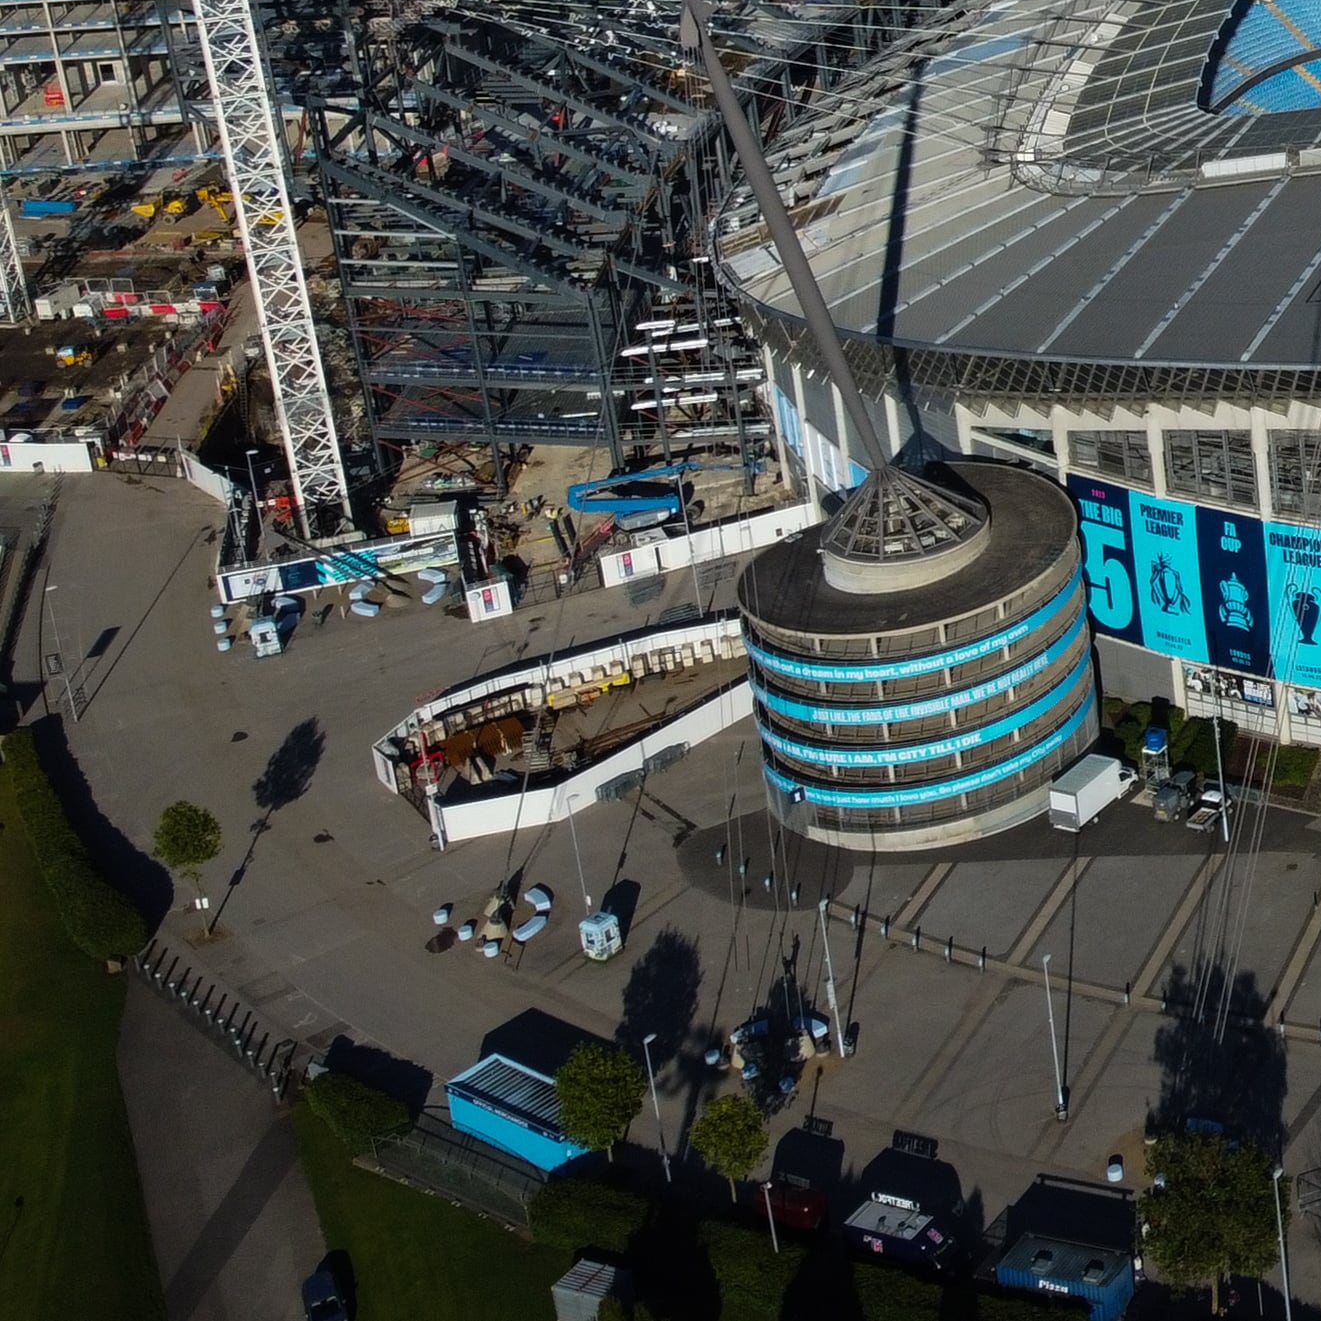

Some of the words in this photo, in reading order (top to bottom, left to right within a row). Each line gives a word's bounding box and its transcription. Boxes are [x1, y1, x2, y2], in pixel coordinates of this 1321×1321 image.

[1078, 498, 1100, 520] THE
[1101, 505, 1123, 528] BIG
[1140, 503, 1184, 526] PREMIER
[1145, 521, 1181, 541] LEAGUE
[1223, 521, 1237, 537] FA
[1220, 535, 1242, 553] CUP
[1080, 520, 1133, 629] 5
[802, 665, 833, 678] dream
[834, 667, 845, 678] in
[850, 669, 864, 680] my
[901, 655, 944, 674] without
[946, 656, 955, 665] a
[955, 648, 978, 662] love
[980, 643, 991, 653] of
[991, 635, 1008, 647] my
[1008, 625, 1029, 639] own
[883, 709, 894, 720] OF
[911, 700, 949, 717] INVISIBLE
[819, 751, 848, 763] SURE
[878, 751, 896, 763] I'M
[898, 747, 927, 761] CITY
[929, 741, 956, 756] TILL
[960, 732, 982, 747] DIE
[951, 778, 981, 792] please
[1039, 1280, 1069, 1293] Pizza
